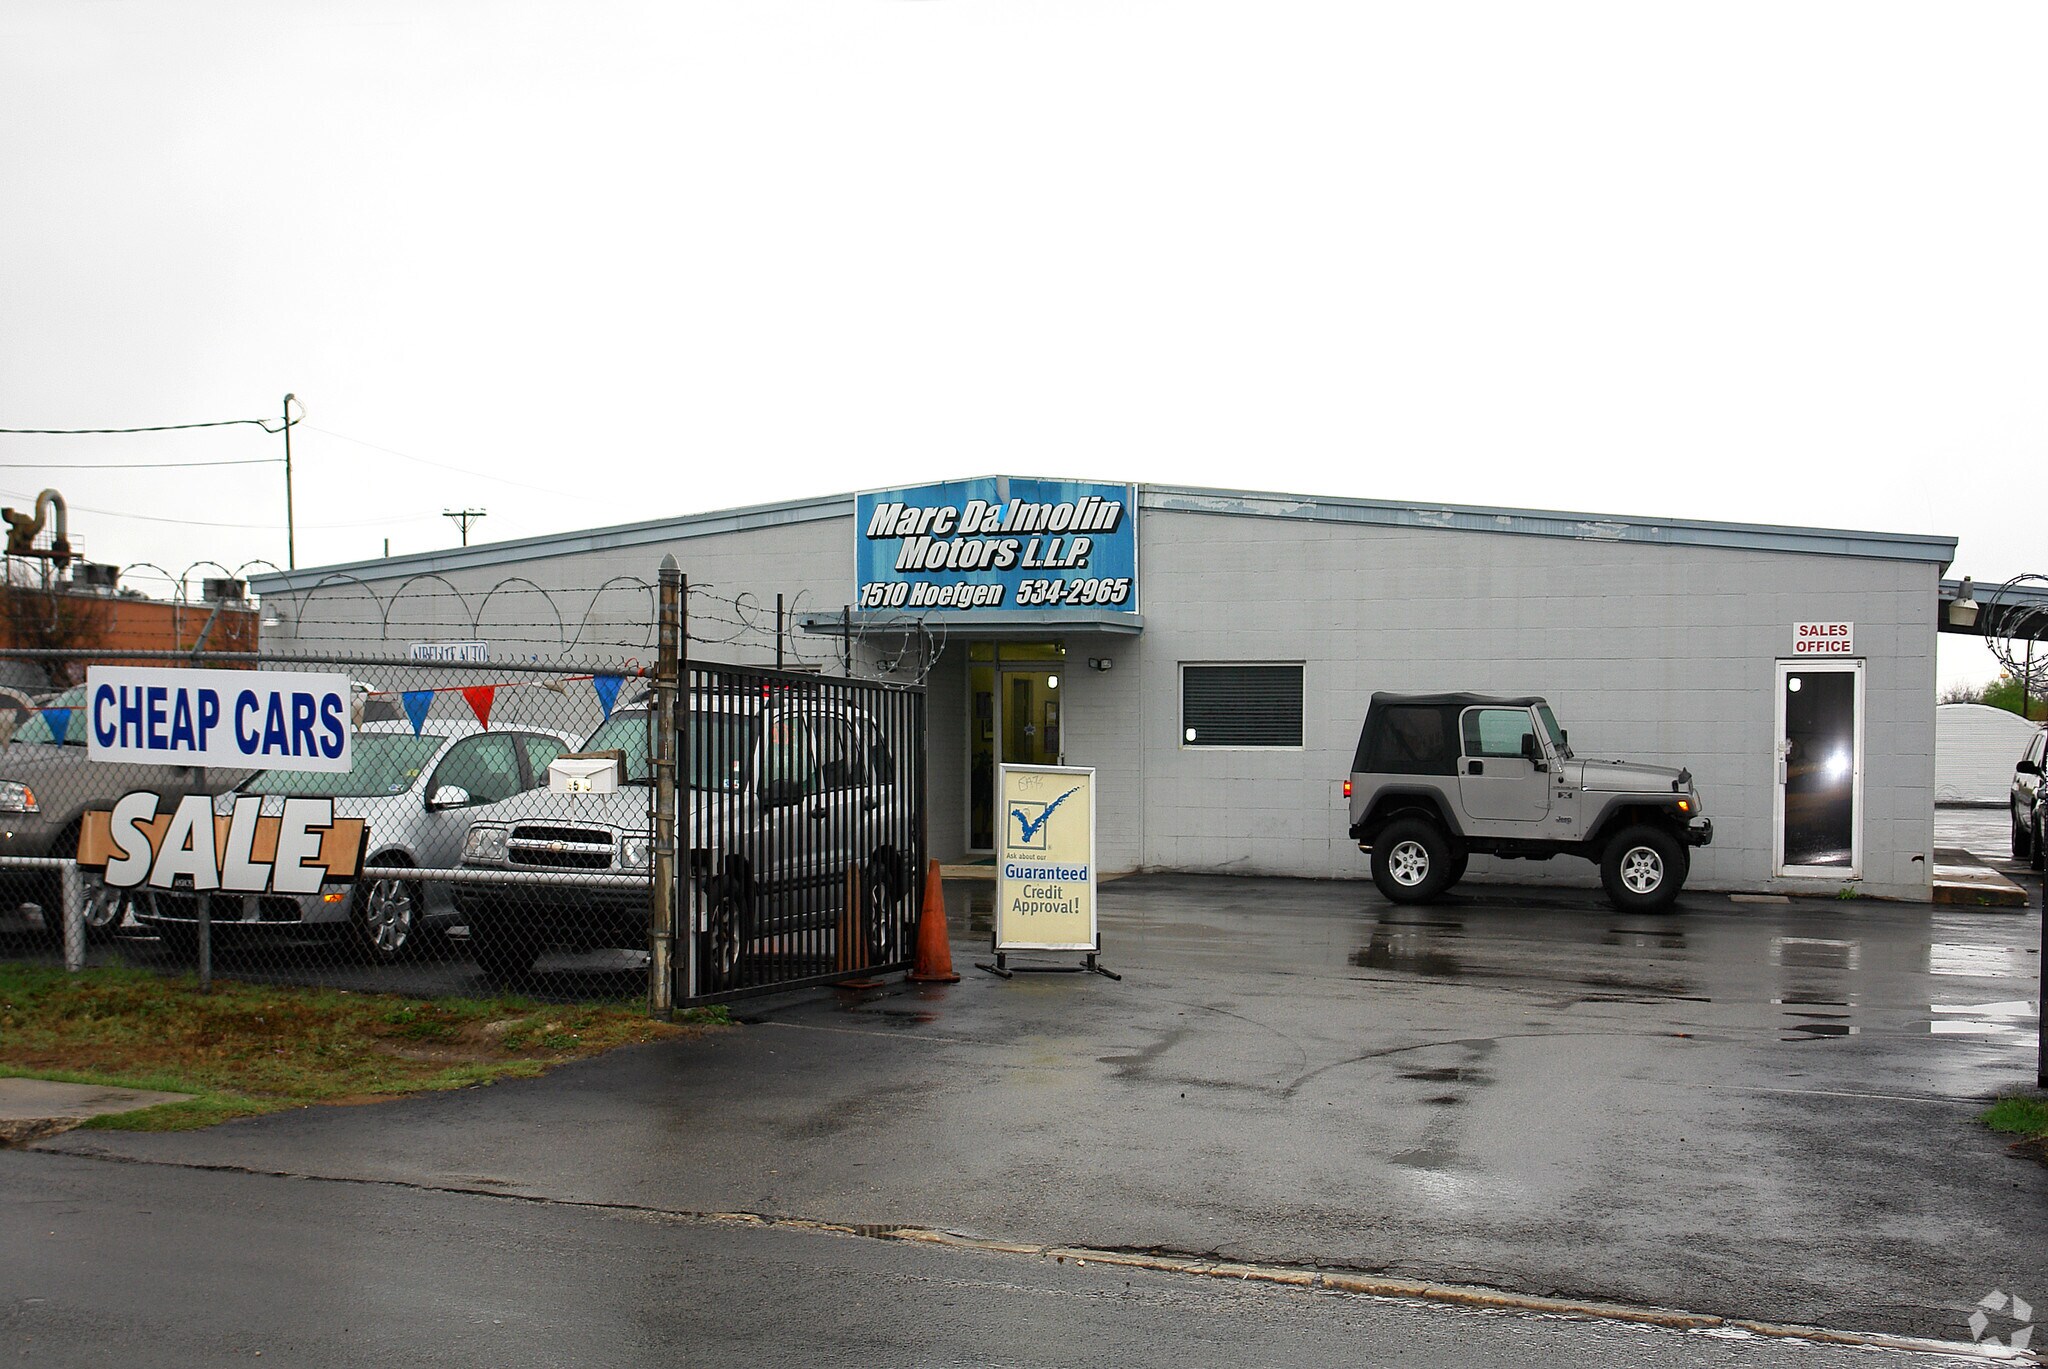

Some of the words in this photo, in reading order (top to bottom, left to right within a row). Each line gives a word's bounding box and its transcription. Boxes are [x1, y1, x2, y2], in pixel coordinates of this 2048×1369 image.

[866, 502, 960, 538] Marc
[957, 497, 1123, 535] Dalmolin
[895, 536, 1021, 571] Motors
[1021, 537, 1093, 569] L.L.P.
[860, 581, 909, 607] 1510
[908, 581, 1006, 609] Hoefgen
[1016, 577, 1131, 605] 534-2965
[1799, 624, 1848, 636] SALES
[1796, 641, 1851, 652] OFFICE
[94, 683, 221, 752] CHEAP
[234, 689, 345, 759] CARS
[1555, 816, 1572, 824] Jeep
[104, 790, 335, 894] SALE
[1006, 852, 1017, 860] Ask
[1019, 852, 1035, 861] about
[1005, 864, 1088, 881] Guaranteed
[1023, 884, 1063, 900] Credit
[1012, 897, 1079, 916] Approval!
